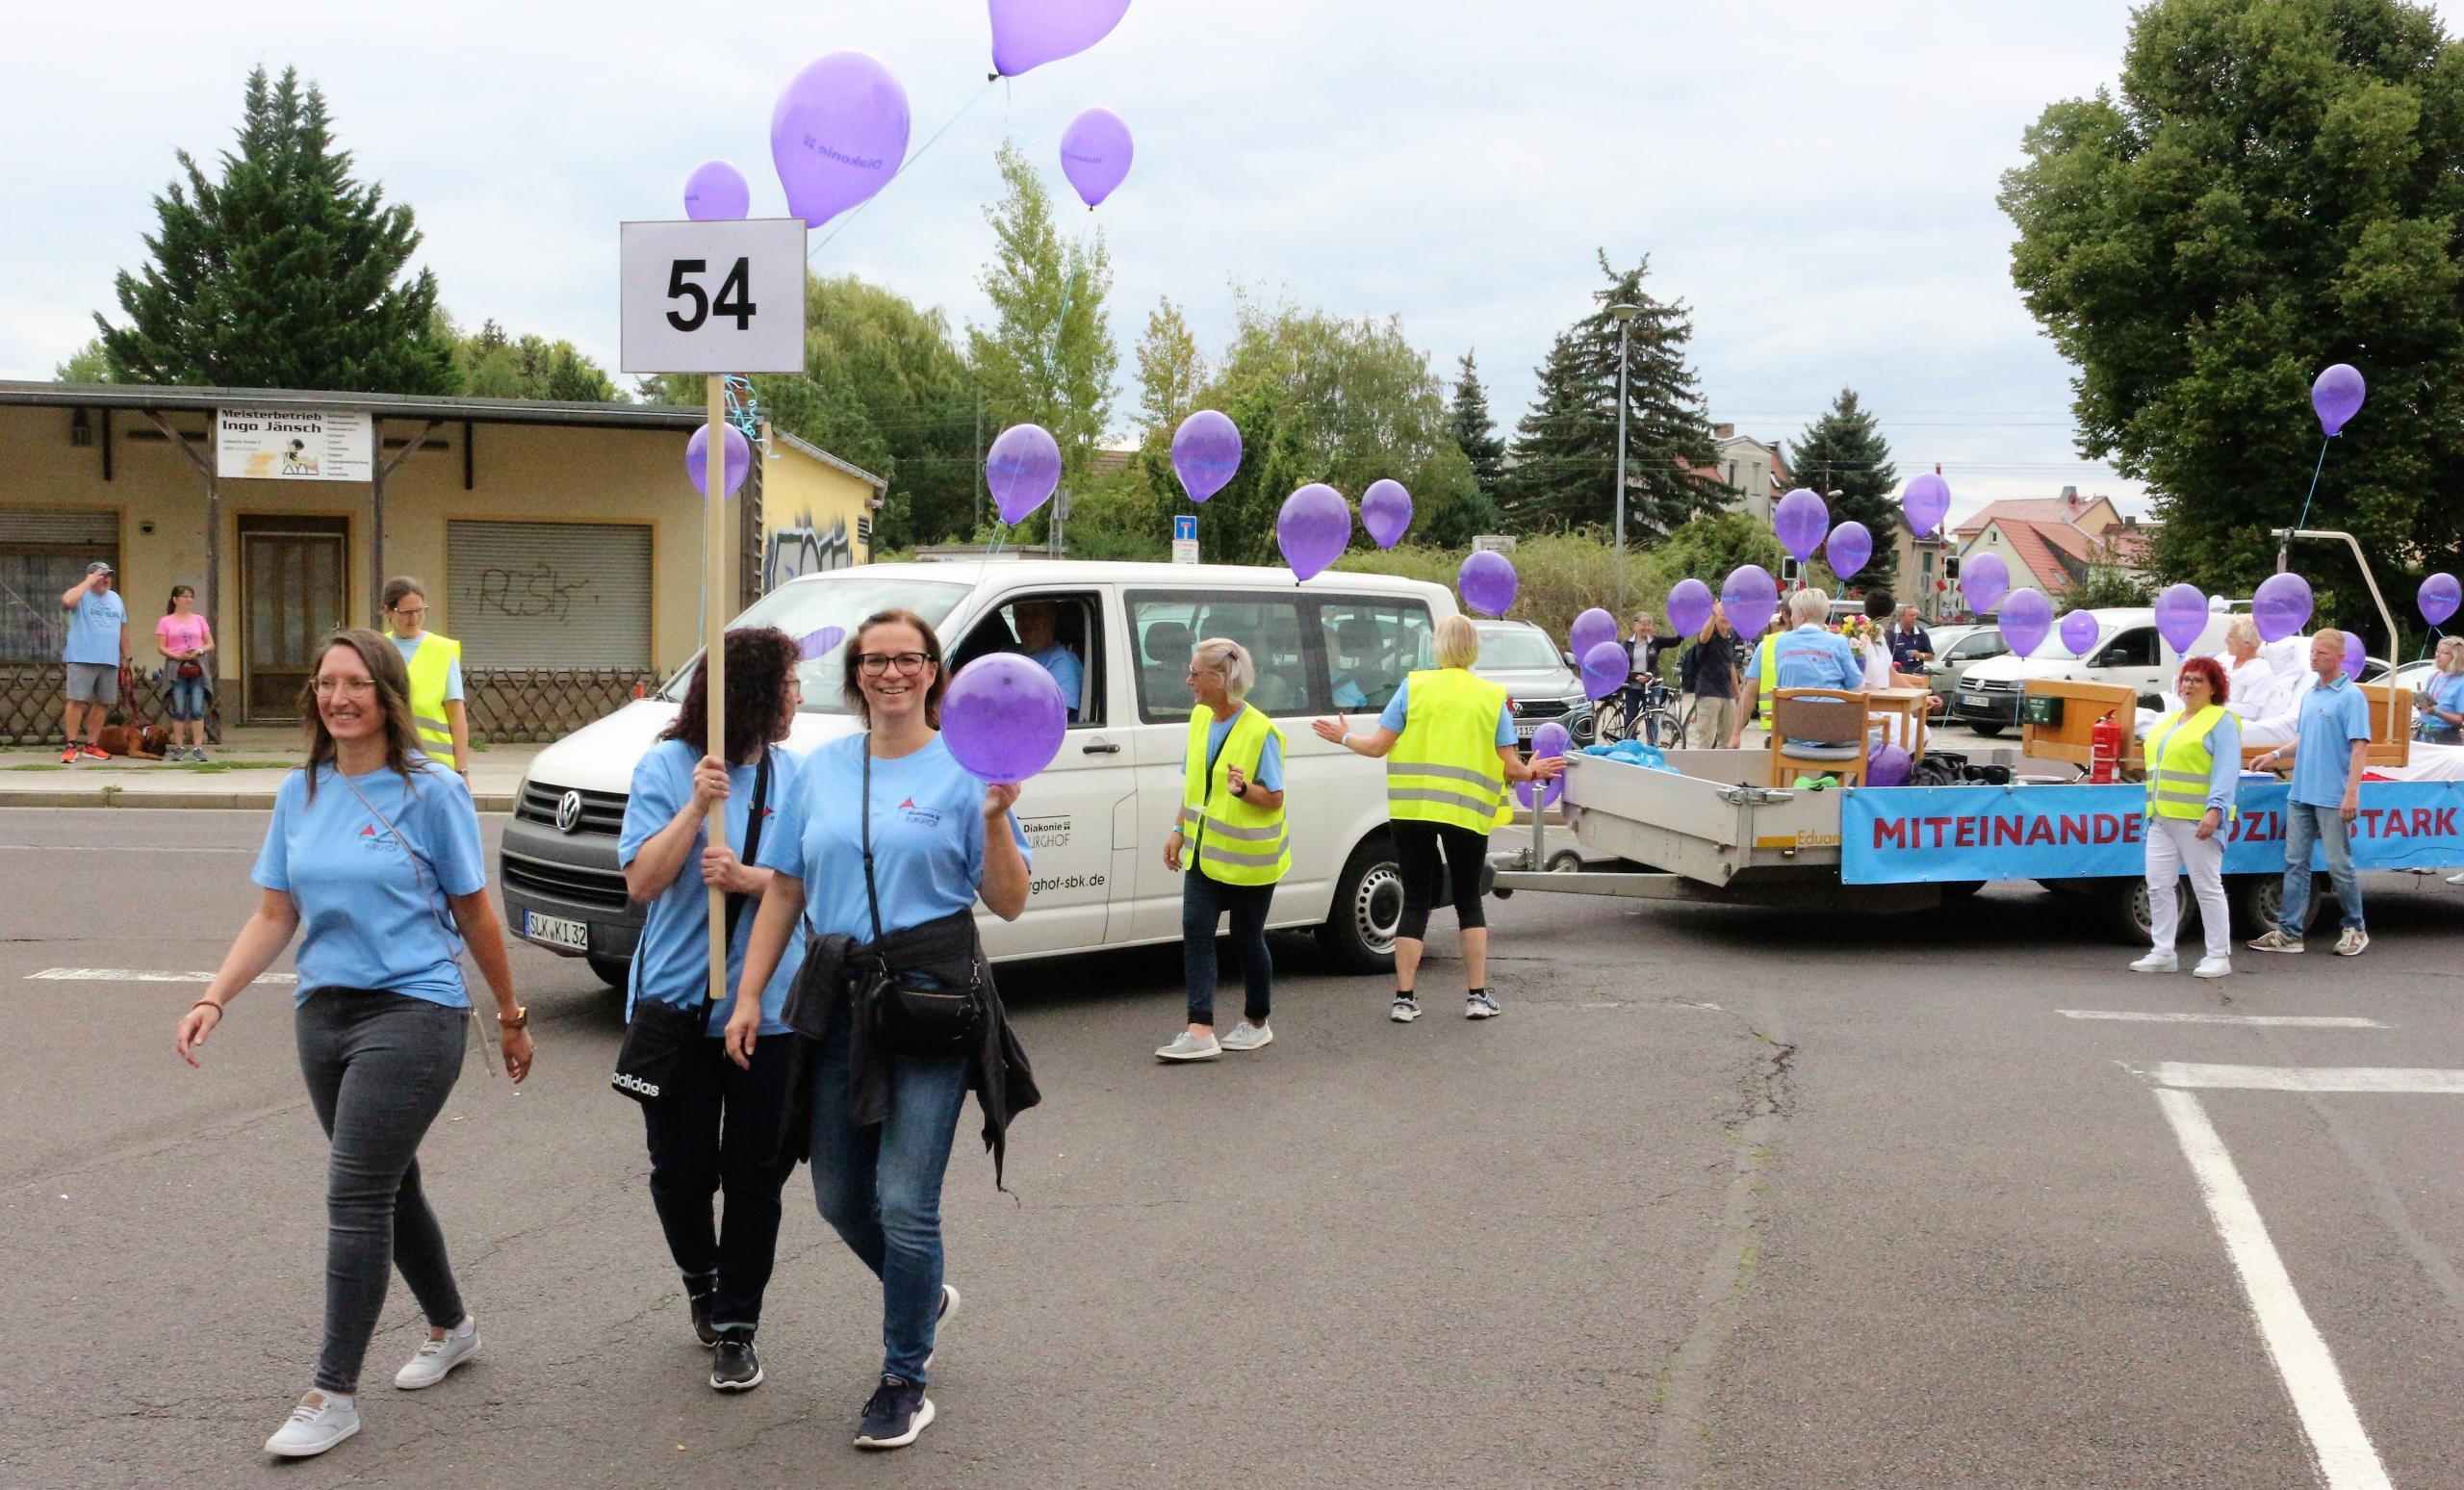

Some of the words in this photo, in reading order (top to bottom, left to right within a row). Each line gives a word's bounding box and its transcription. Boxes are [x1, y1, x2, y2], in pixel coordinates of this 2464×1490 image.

[666, 257, 757, 332] 54
[221, 409, 322, 422] Meisterbetrieb
[222, 420, 259, 433] Ingo
[264, 421, 322, 433] Jänsch
[1023, 821, 1063, 834] Diakonie
[1873, 812, 2143, 849] MITEINANDE
[1029, 833, 1070, 848] URGHOF
[1028, 873, 1105, 895] rghof-sbk.de
[529, 914, 548, 938] SLK
[572, 924, 586, 946] 32
[612, 1072, 660, 1097] adidas
